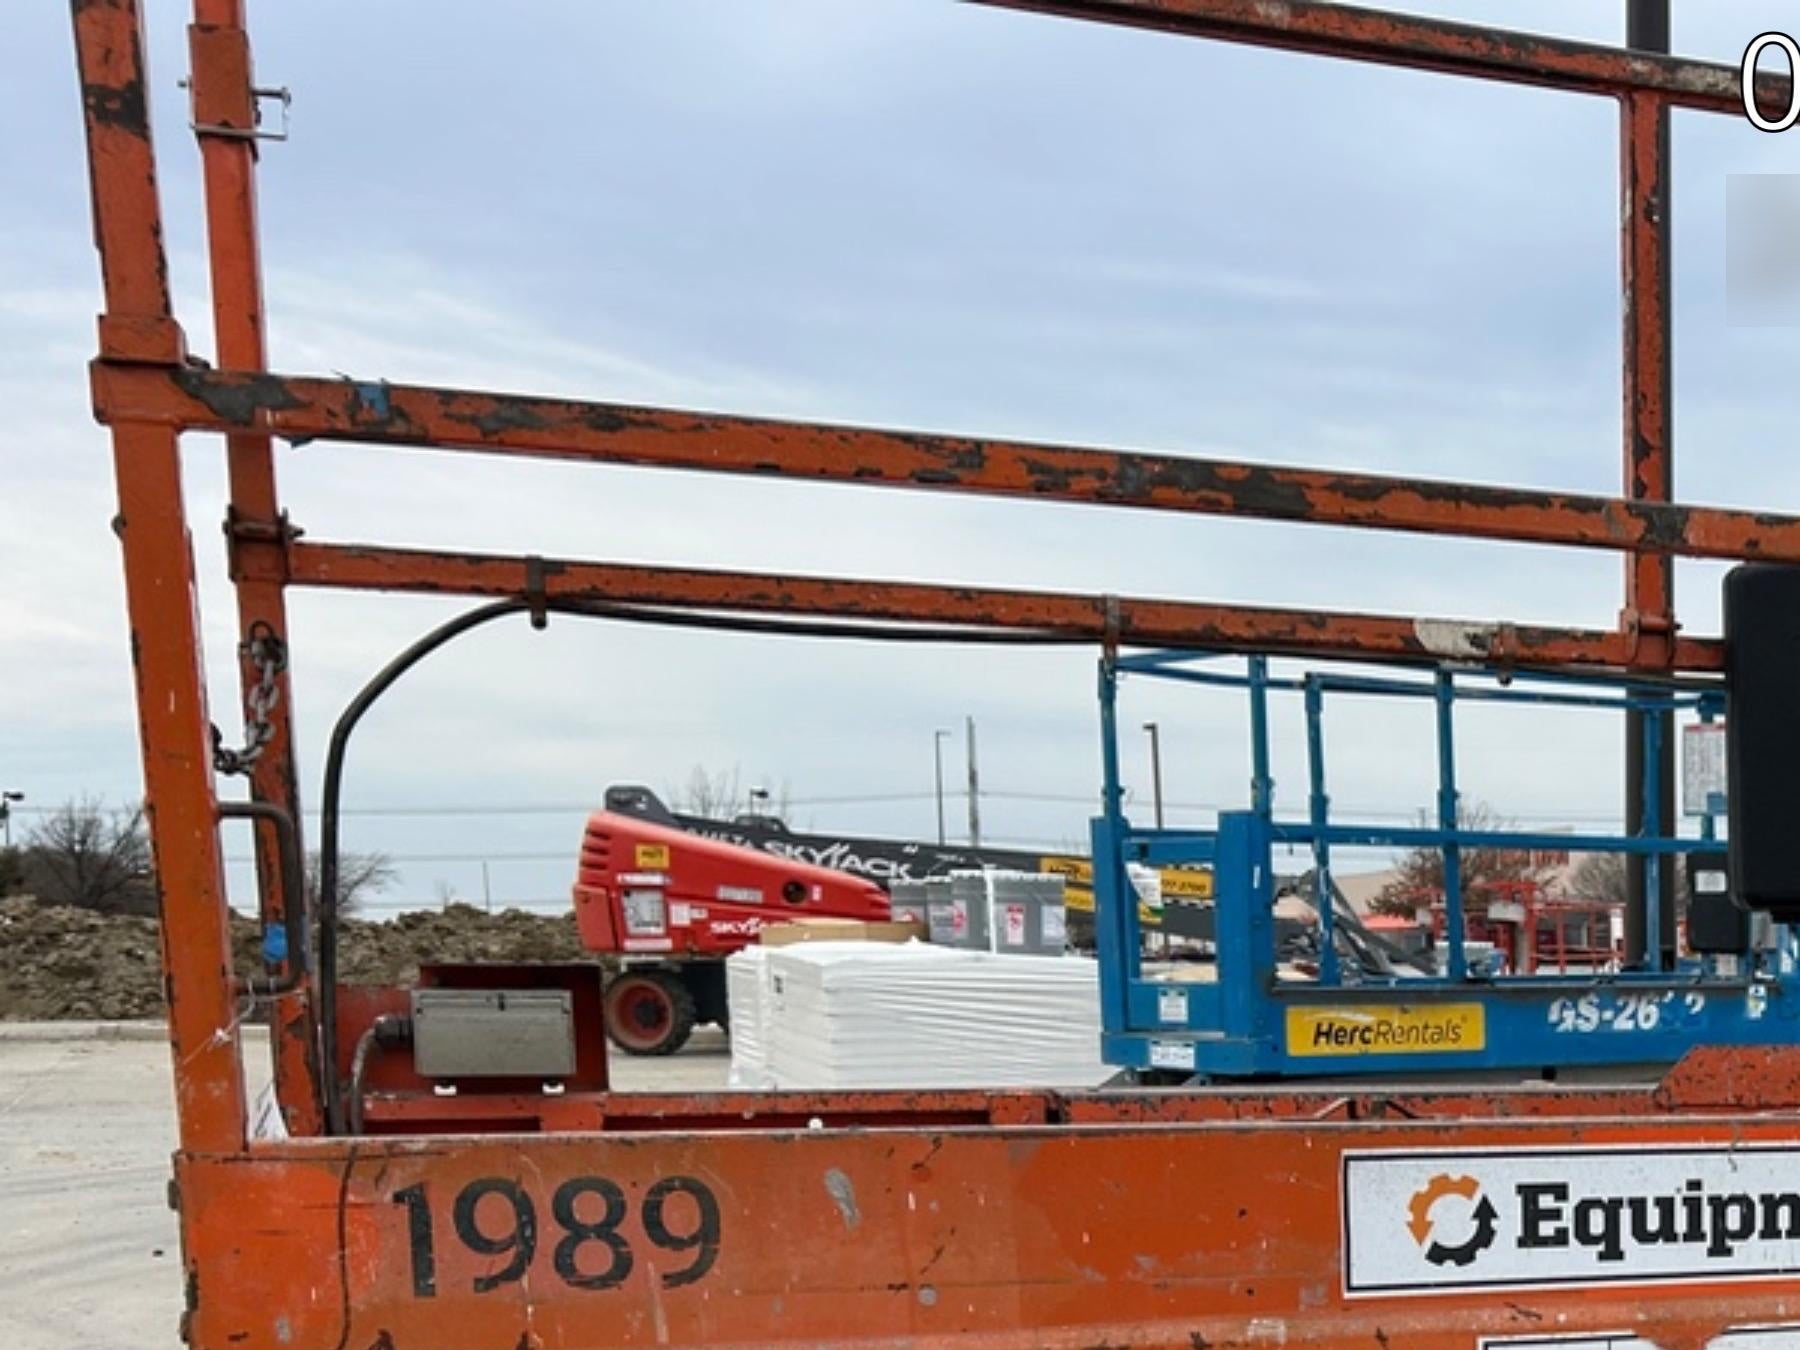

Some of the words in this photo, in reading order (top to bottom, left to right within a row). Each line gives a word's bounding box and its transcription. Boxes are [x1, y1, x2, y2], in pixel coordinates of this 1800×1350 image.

[764, 842, 912, 879] SKYJACK
[1313, 1018, 1462, 1047] HercRentals
[392, 1175, 721, 1298] 1989
